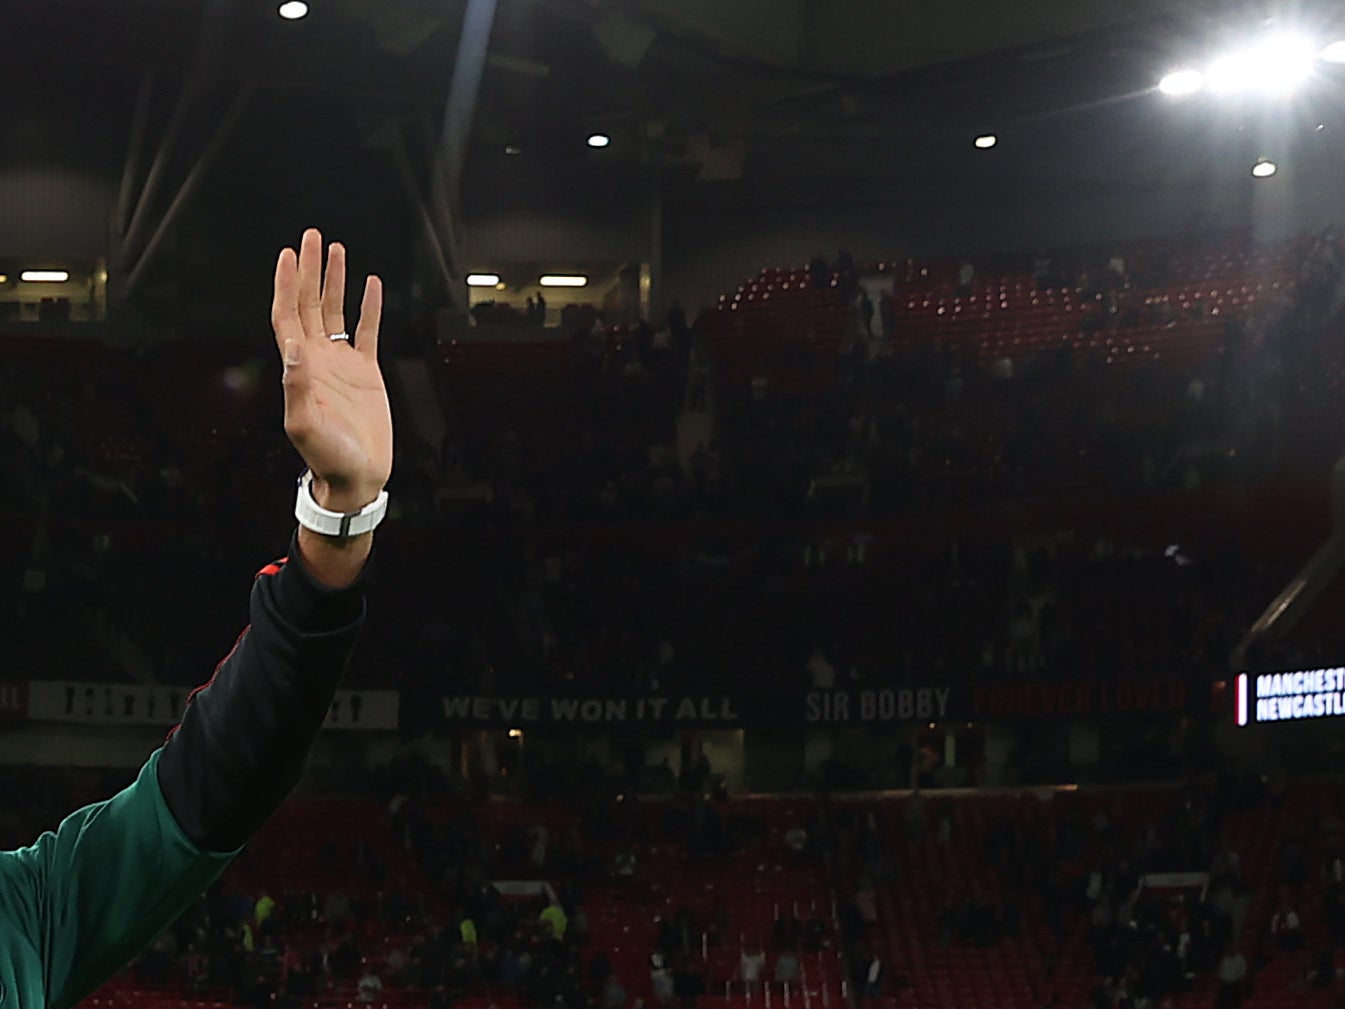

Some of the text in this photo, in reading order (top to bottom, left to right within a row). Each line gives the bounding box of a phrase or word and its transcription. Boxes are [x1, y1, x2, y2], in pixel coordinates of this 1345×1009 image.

[1256, 666, 1345, 698] MANCHEST
[551, 698, 626, 722] WON
[636, 698, 667, 720] IT
[675, 697, 739, 721] ALL
[806, 686, 952, 721] SIR BOBBY
[1256, 690, 1345, 722] NEWCASTL
